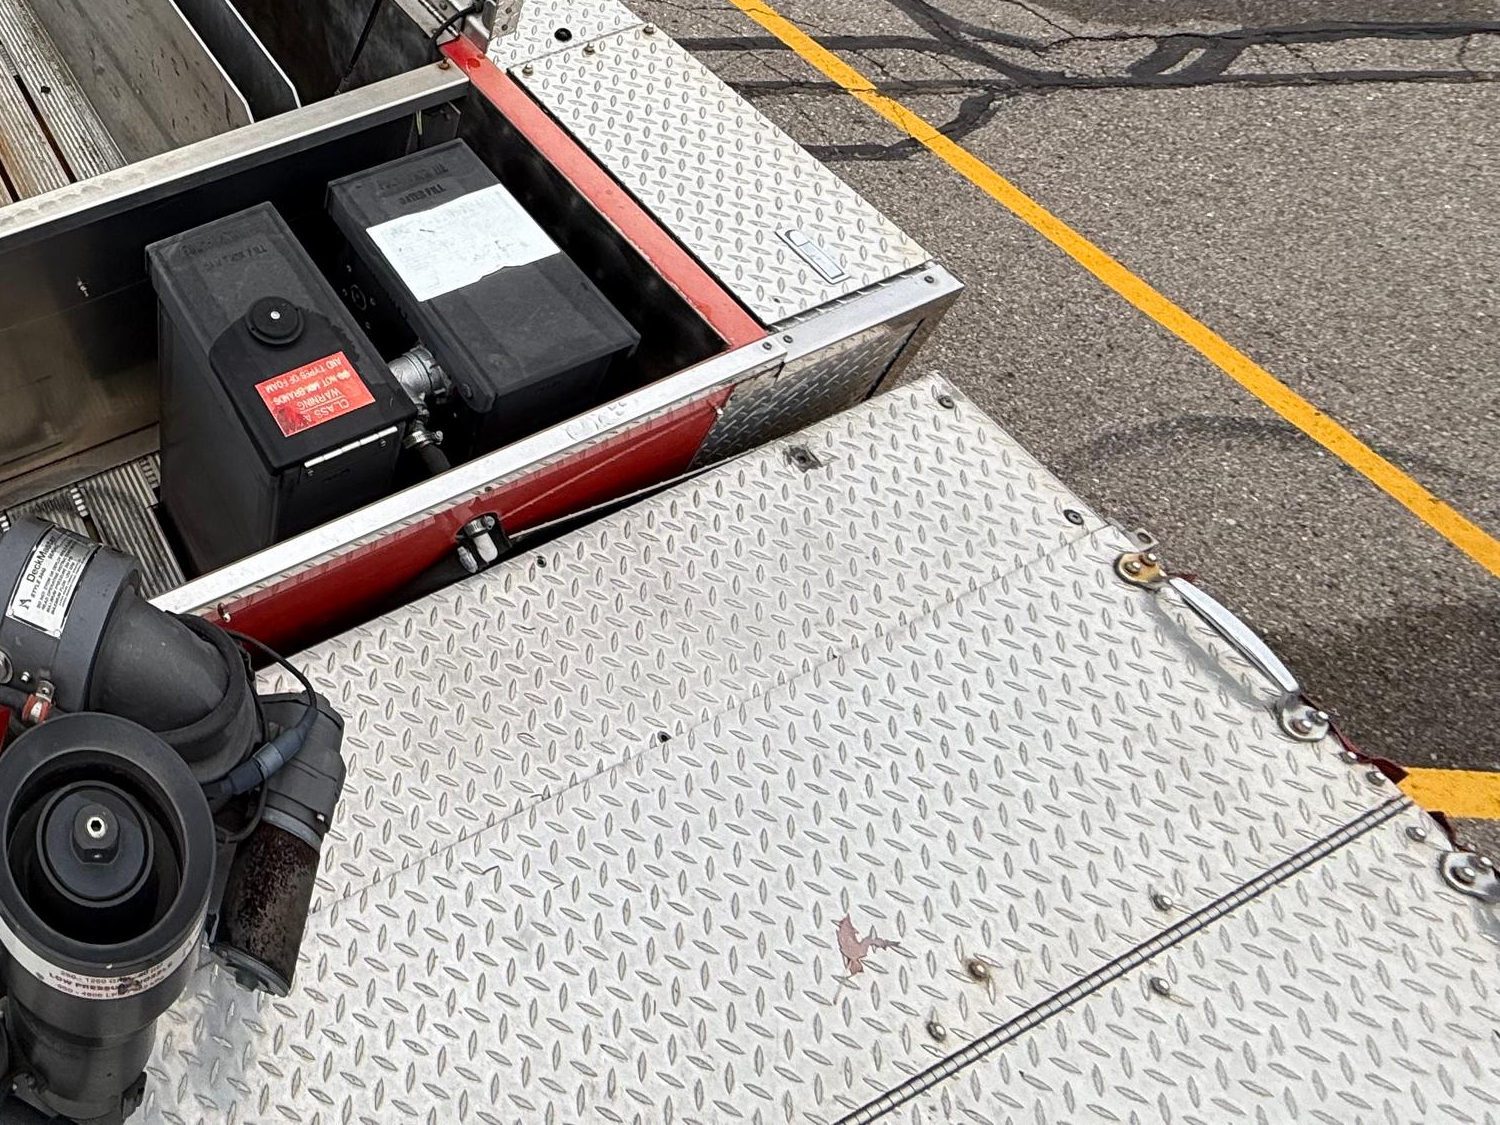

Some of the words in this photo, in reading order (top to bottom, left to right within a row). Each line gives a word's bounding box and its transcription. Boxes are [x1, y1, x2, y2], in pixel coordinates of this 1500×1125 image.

[325, 357, 341, 369] AND
[287, 374, 299, 384] OF
[299, 364, 325, 379] TYPES
[264, 379, 288, 392] FOAM
[320, 375, 336, 386] NOT
[272, 386, 305, 405] BRANDS
[295, 387, 341, 410] WARNING
[314, 397, 349, 418] CLASS
[26, 536, 56, 583] DeckMaster
[31, 580, 41, 598] STYLE
[48, 972, 71, 985] LOW
